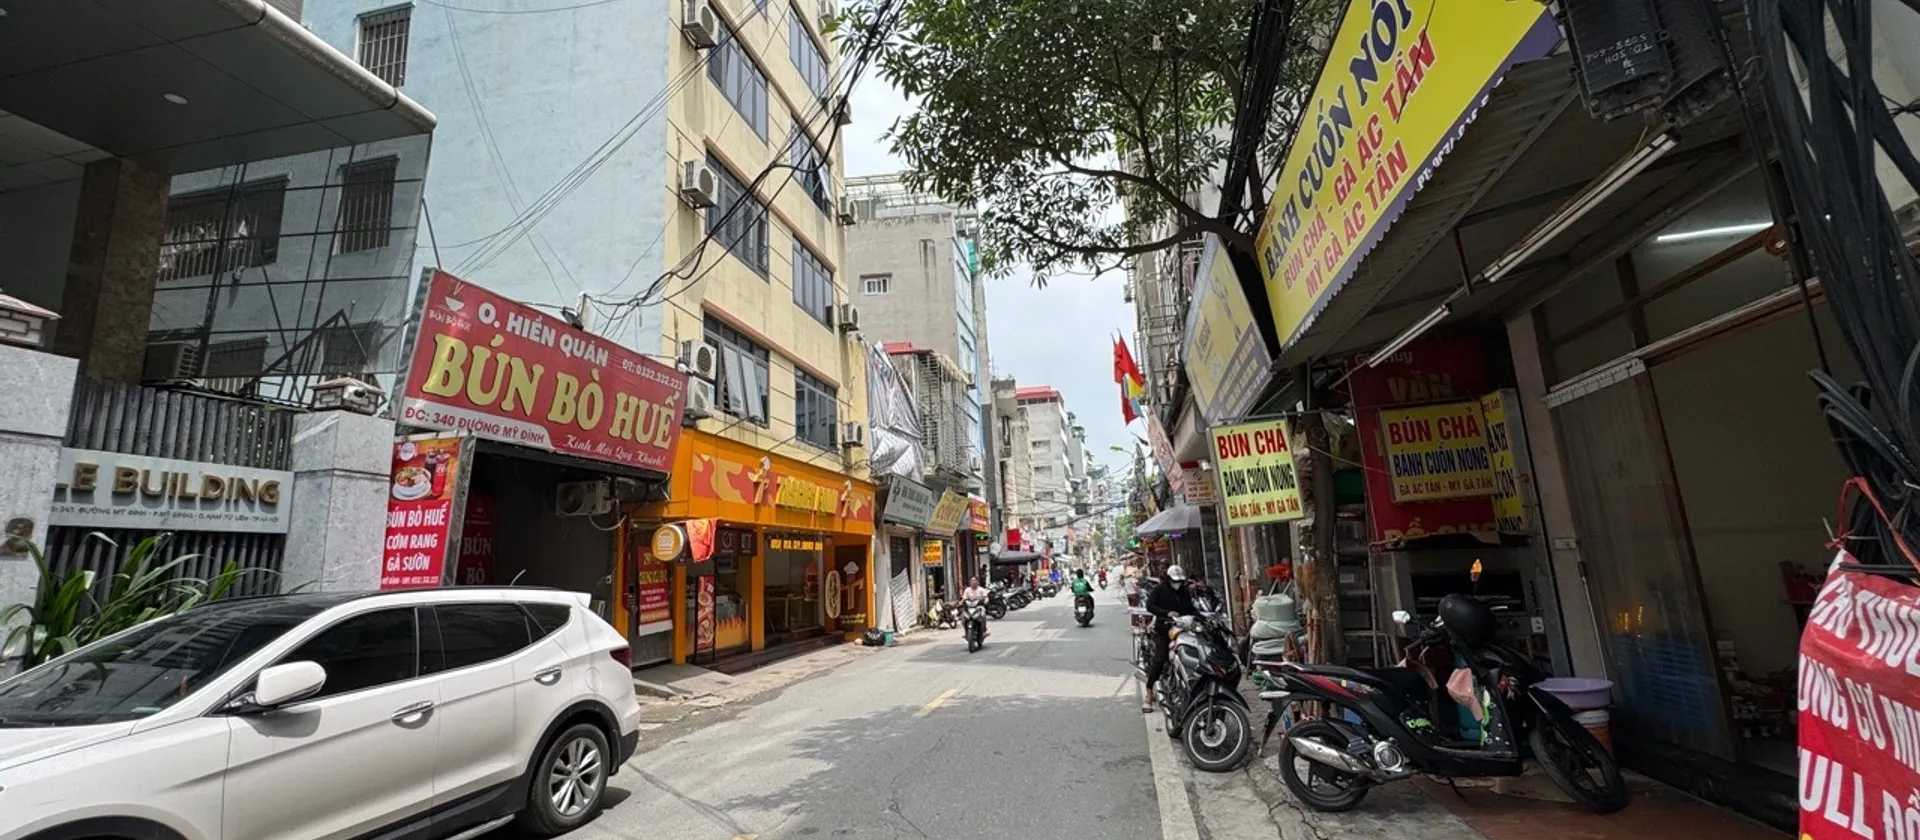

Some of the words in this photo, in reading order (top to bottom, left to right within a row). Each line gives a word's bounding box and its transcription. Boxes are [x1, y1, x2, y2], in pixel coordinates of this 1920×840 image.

[1265, 194, 1301, 280] BÁNH
[1299, 85, 1354, 209] CUỐN
[1349, 0, 1412, 106] NÓ
[1284, 248, 1304, 290] BÚN
[1303, 205, 1327, 257] CHẢ
[1333, 160, 1358, 204] GÀ
[1356, 112, 1384, 171] ÁC
[1382, 29, 1436, 124] TẦN
[1324, 232, 1344, 272] GÀ
[1344, 201, 1366, 246] ÁC
[1364, 139, 1409, 204] TẦN
[478, 302, 500, 329] O.
[506, 314, 555, 348] HIỀN
[559, 334, 609, 368] QUÁN
[421, 332, 544, 416] BÚN
[547, 367, 603, 431] BÒ
[609, 390, 680, 450] HUẾ
[405, 407, 430, 423] ĐC:
[432, 410, 455, 426] 340
[458, 415, 500, 435] ĐƯỜNG
[502, 422, 519, 438] MỸ
[520, 428, 545, 443] ĐÌNH
[1217, 429, 1251, 460] BÚN
[1254, 423, 1288, 455] CHẢ
[1388, 415, 1432, 445] BÚN
[1436, 407, 1481, 442] CHẢ
[1223, 466, 1248, 497] BÁNH
[1247, 459, 1271, 494] CUỐN
[1270, 460, 1295, 491] NÓNG
[1393, 450, 1424, 477] BÁNH
[1425, 442, 1456, 474] CUỐN
[1457, 445, 1490, 472] NÓNG
[57, 462, 99, 490] E
[112, 466, 280, 504] BUILDING
[386, 505, 405, 528] BÚN
[407, 504, 422, 527] BÒ
[424, 501, 449, 526] HUẾ
[386, 533, 409, 550] CƠM
[410, 533, 438, 549] RANG
[387, 553, 400, 571] GÀ
[402, 552, 430, 571] SƯỜN
[1798, 746, 1874, 840] ULL
